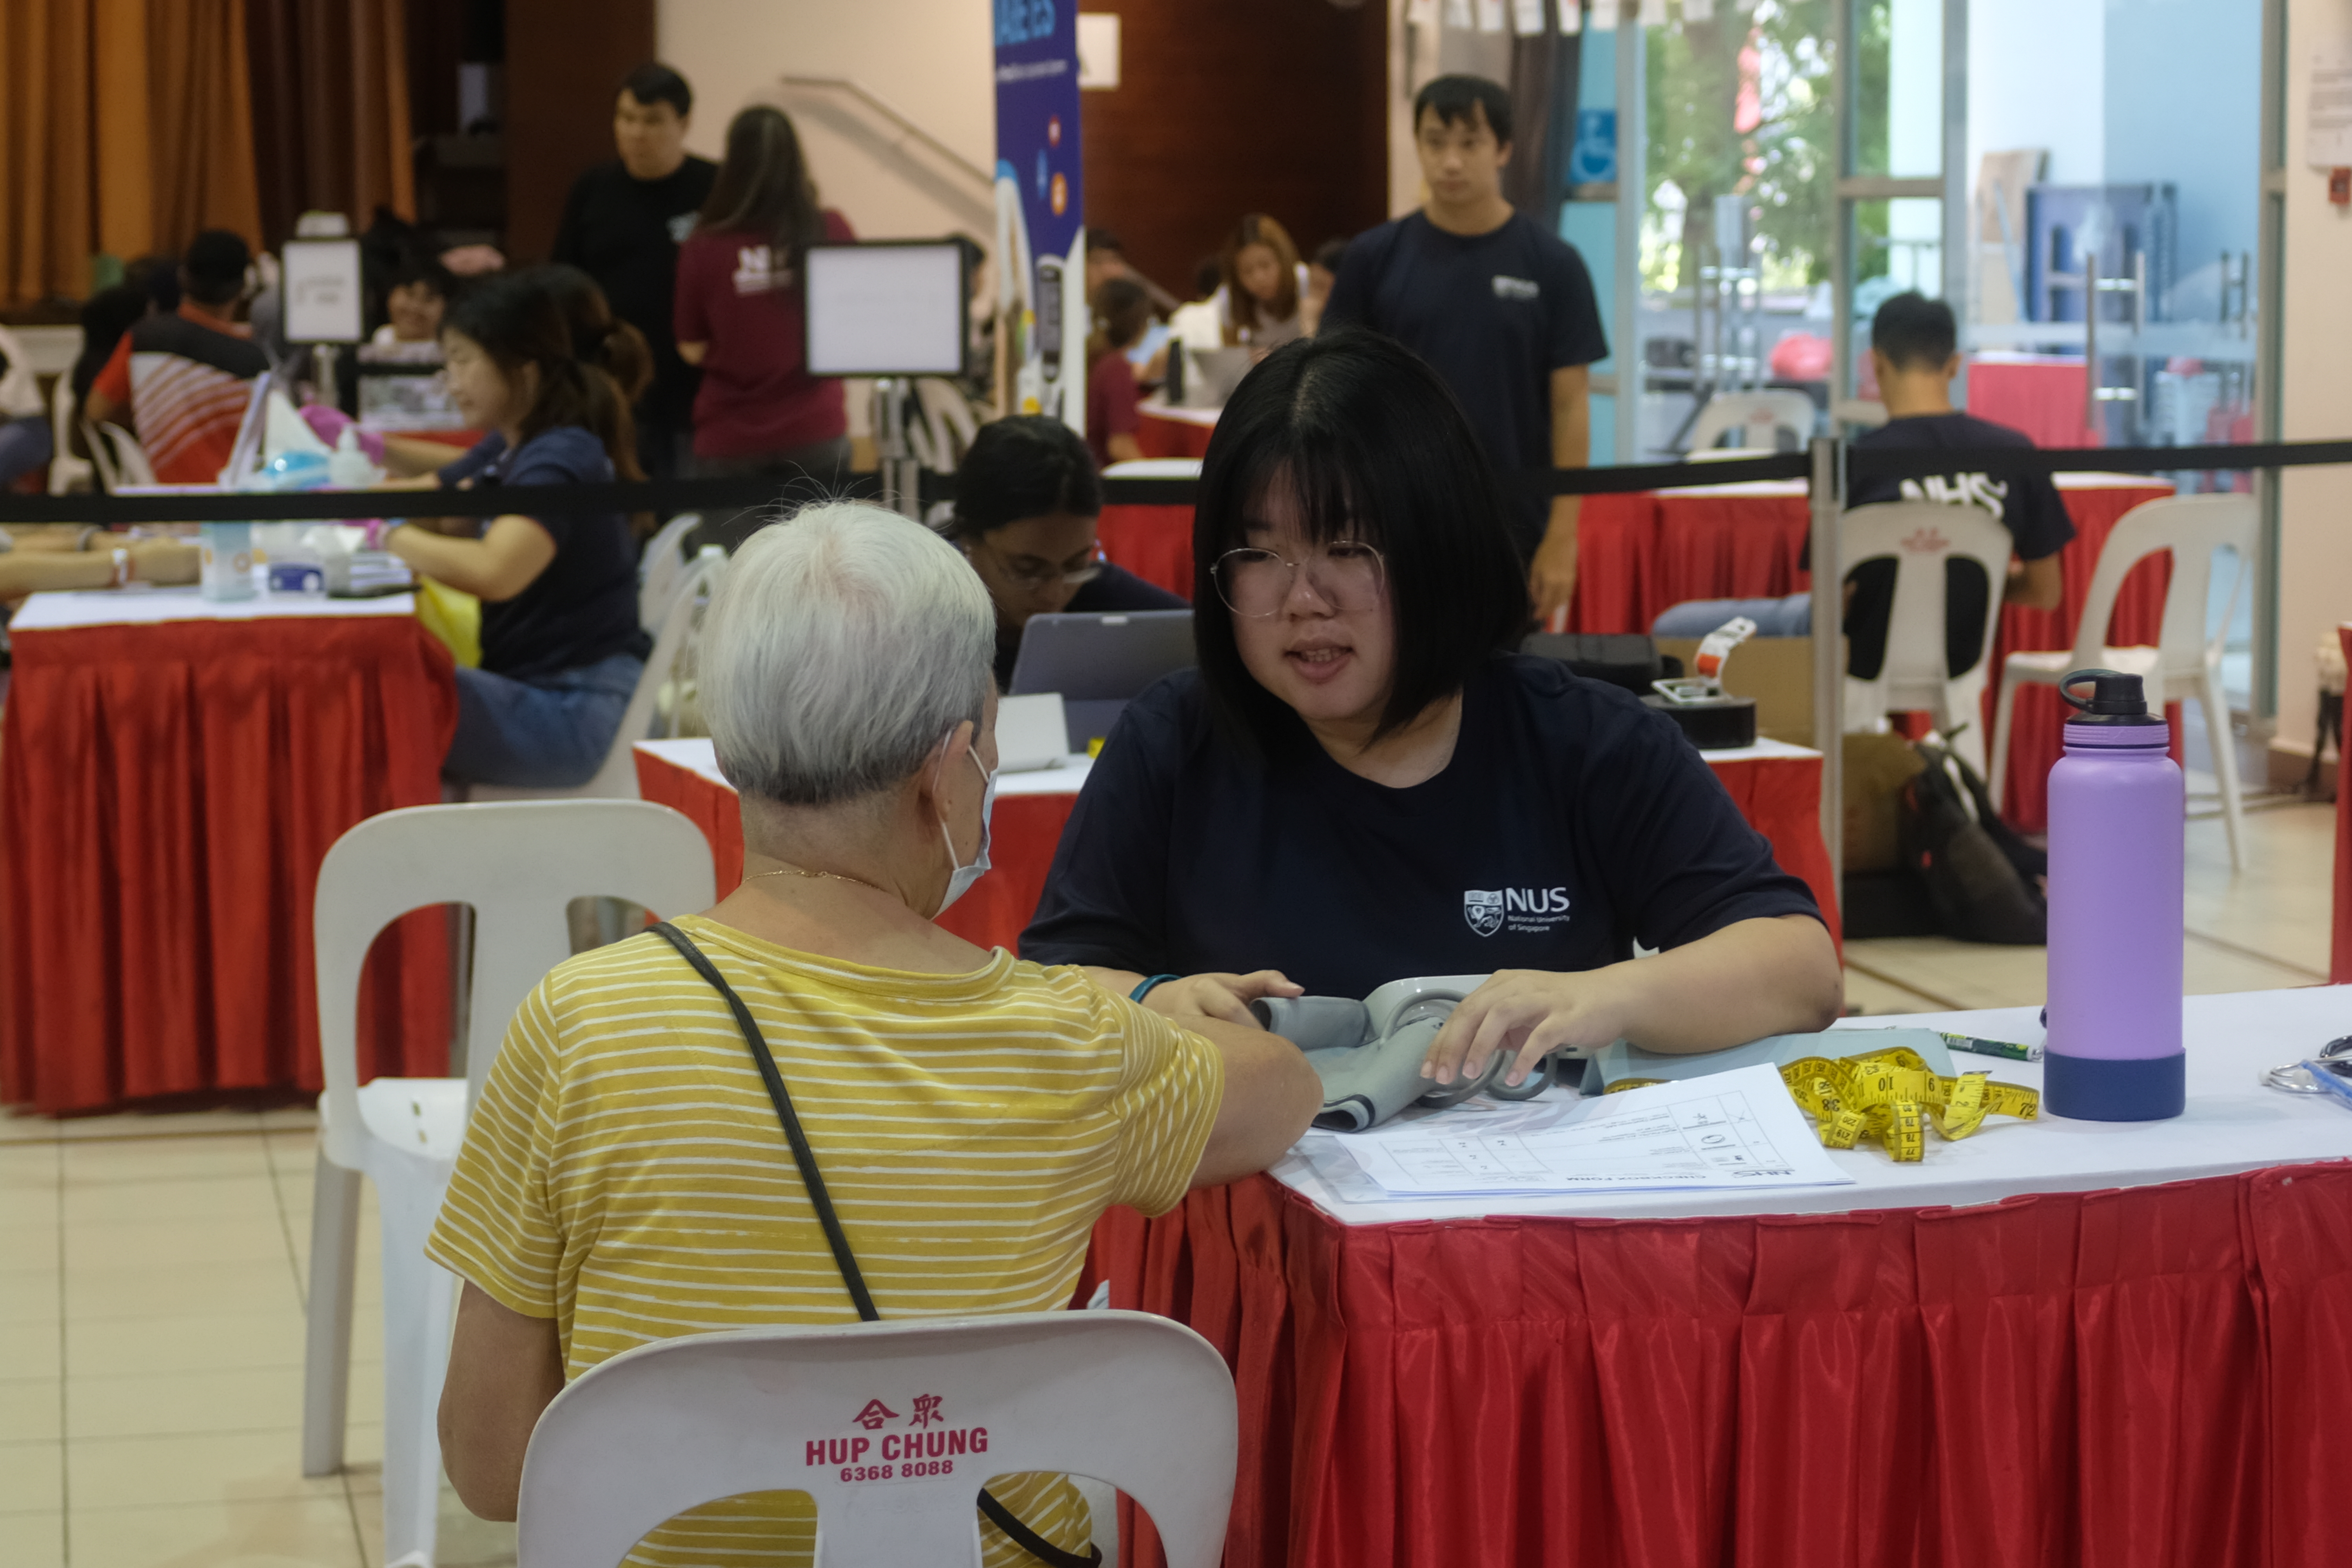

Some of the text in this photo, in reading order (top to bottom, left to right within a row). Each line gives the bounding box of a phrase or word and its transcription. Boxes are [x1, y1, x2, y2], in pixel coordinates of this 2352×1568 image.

[1506, 887, 1570, 913] NUS
[1517, 924, 1550, 933] Singapore
[1878, 1076, 1894, 1091] 10
[1822, 1099, 1840, 1112] 38
[2020, 1102, 2036, 1116] 72
[1842, 1116, 1857, 1127] 220
[1836, 1129, 1851, 1141] 219
[1906, 1133, 1915, 1142] 78
[806, 1427, 988, 1466] HUP CHUNG
[840, 1460, 953, 1482] 6368 8088
